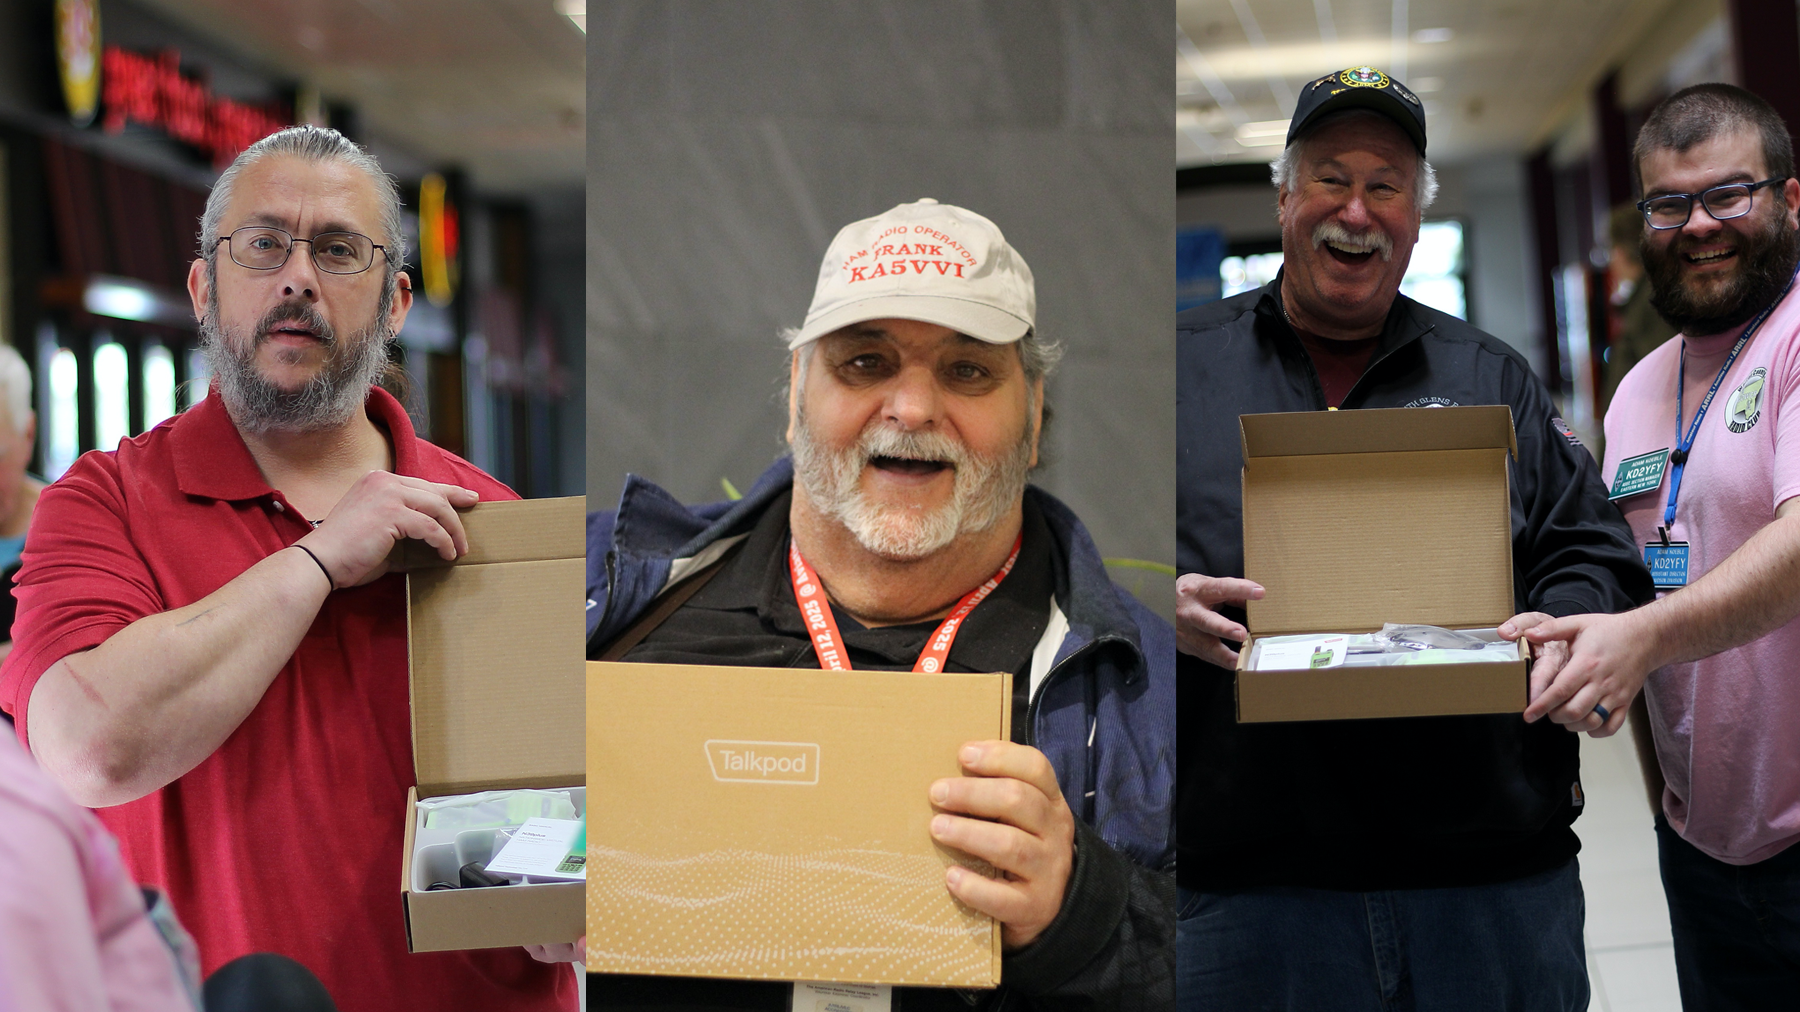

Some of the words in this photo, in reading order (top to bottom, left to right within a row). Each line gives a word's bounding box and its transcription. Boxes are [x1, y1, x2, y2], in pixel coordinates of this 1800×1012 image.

[843, 250, 868, 271] HAM
[871, 226, 908, 250] RADIO
[914, 225, 978, 267] OPERATOR
[873, 243, 944, 262] FRANK
[848, 259, 965, 284] KA5VVI
[1701, 389, 1716, 412] ARRL
[1731, 336, 1748, 357] ARRL
[1419, 396, 1451, 406] GLENS
[1625, 461, 1663, 480] KD2YFY
[1654, 557, 1686, 569] KD2YFY
[799, 583, 817, 598] @
[967, 578, 999, 606] April
[803, 599, 828, 631] 2025
[816, 629, 835, 650] 12,
[932, 618, 960, 651] 2025
[822, 650, 847, 671] pril
[921, 656, 939, 673] @
[719, 749, 806, 776] Talkpod
